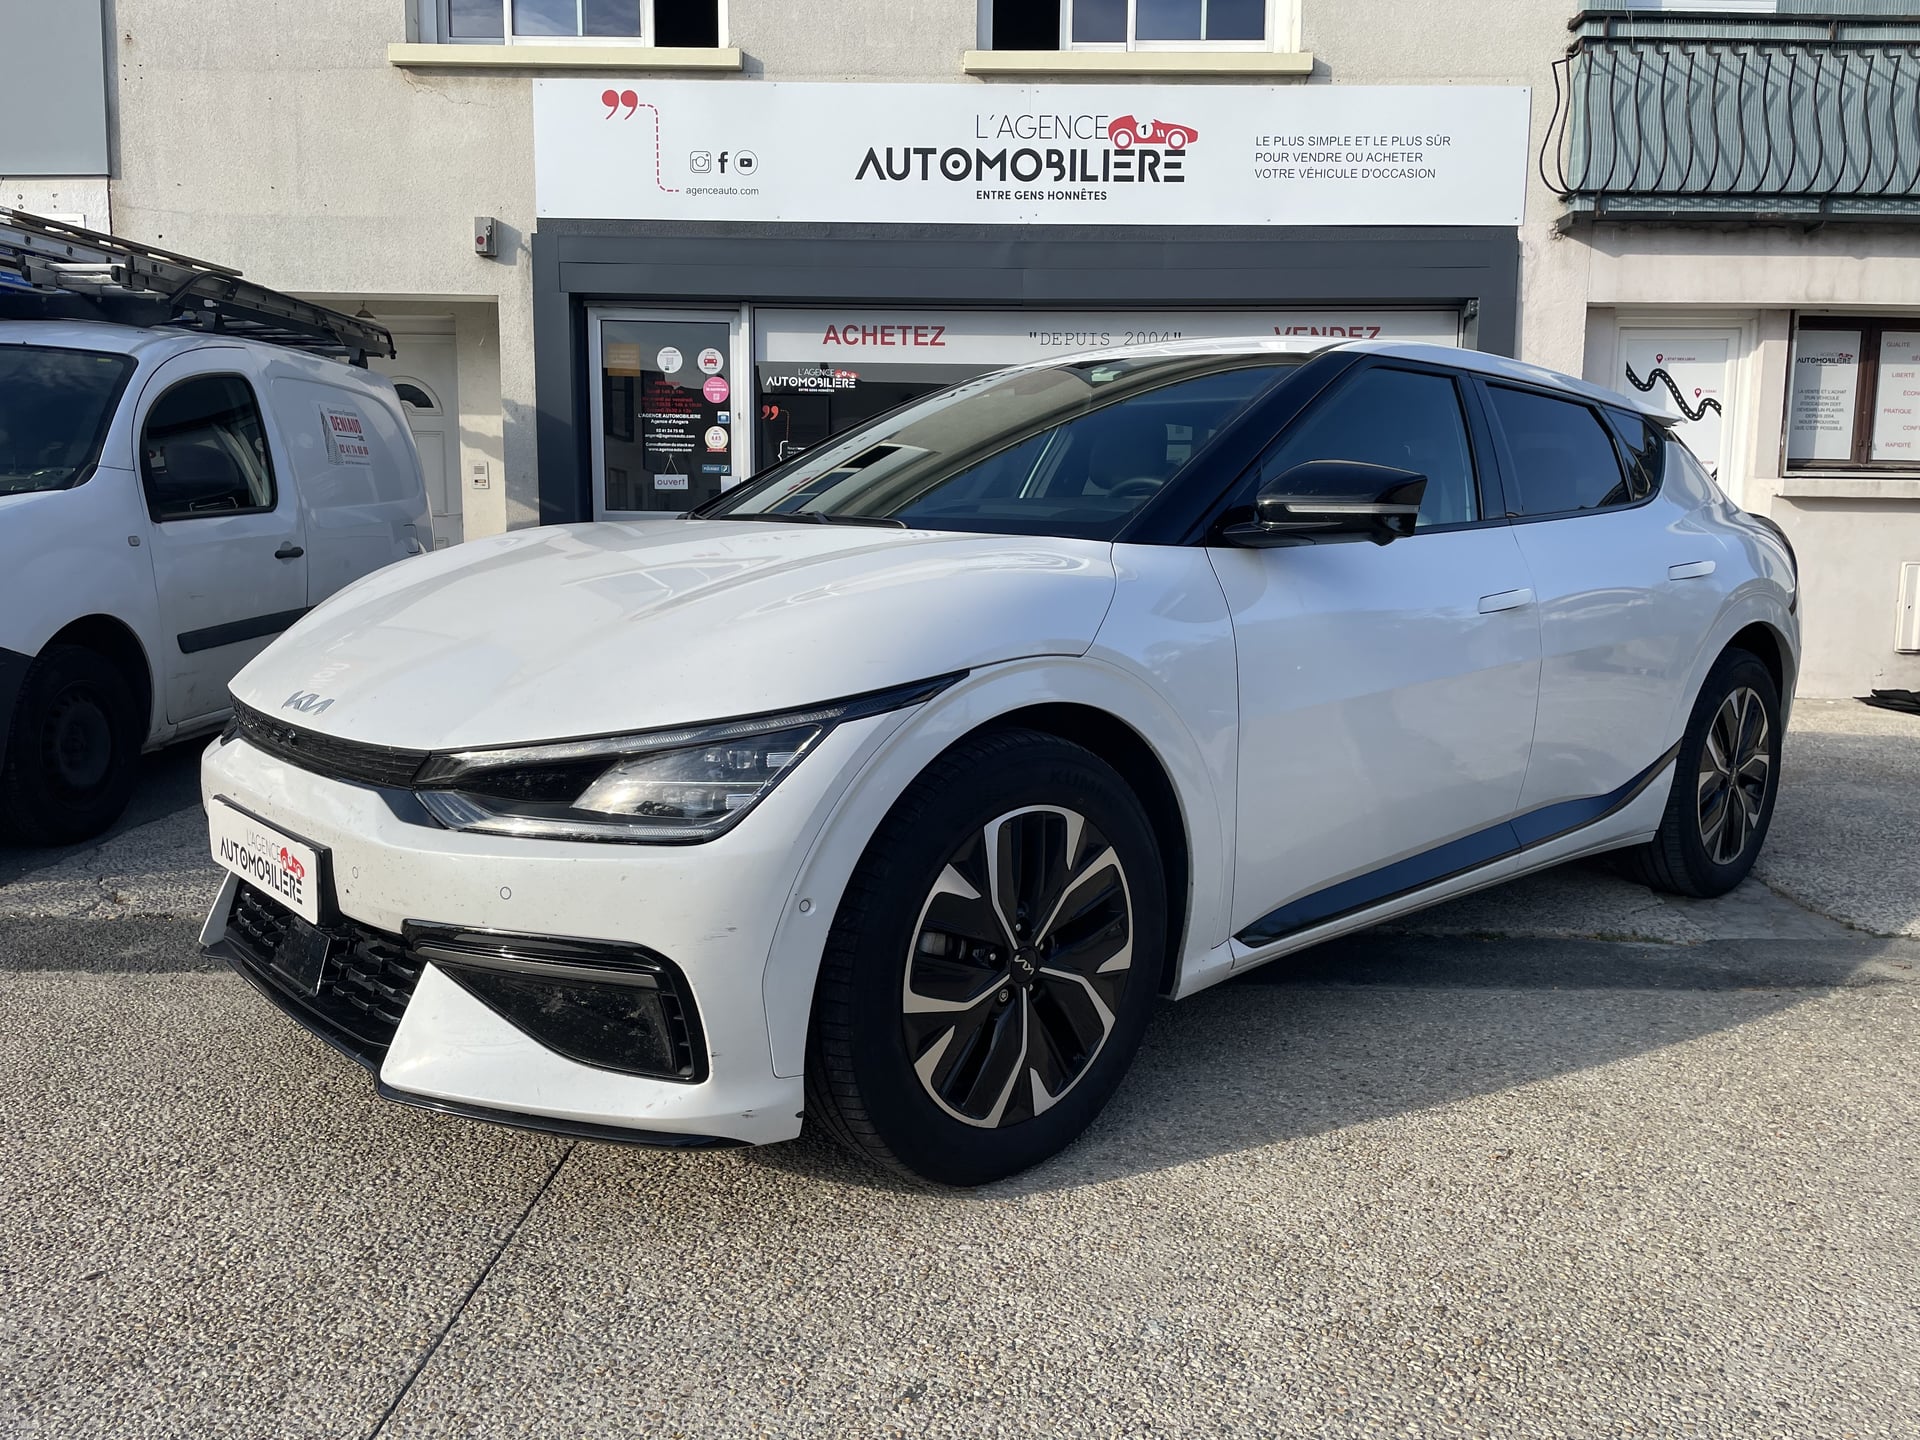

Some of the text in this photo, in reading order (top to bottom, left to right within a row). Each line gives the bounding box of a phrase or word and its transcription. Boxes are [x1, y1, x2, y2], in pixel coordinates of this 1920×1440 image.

[976, 114, 1109, 139] L'AGENCE
[1255, 134, 1451, 147] LE PLUS SIMPLE ET LE PLUS SÛR
[1255, 152, 1423, 163] POUR VENDRE OU ACHETER
[1254, 166, 1436, 179] VOTRE VÉHICULE D'OCCASION
[685, 187, 760, 196] agenceauto.com
[976, 188, 1108, 200] ENTRE GENS HONNÊTES
[823, 324, 946, 346] ACHETEZ
[798, 368, 835, 377] L'AGENCE
[330, 415, 363, 434] DENIAUD
[656, 478, 685, 486] ouvert
